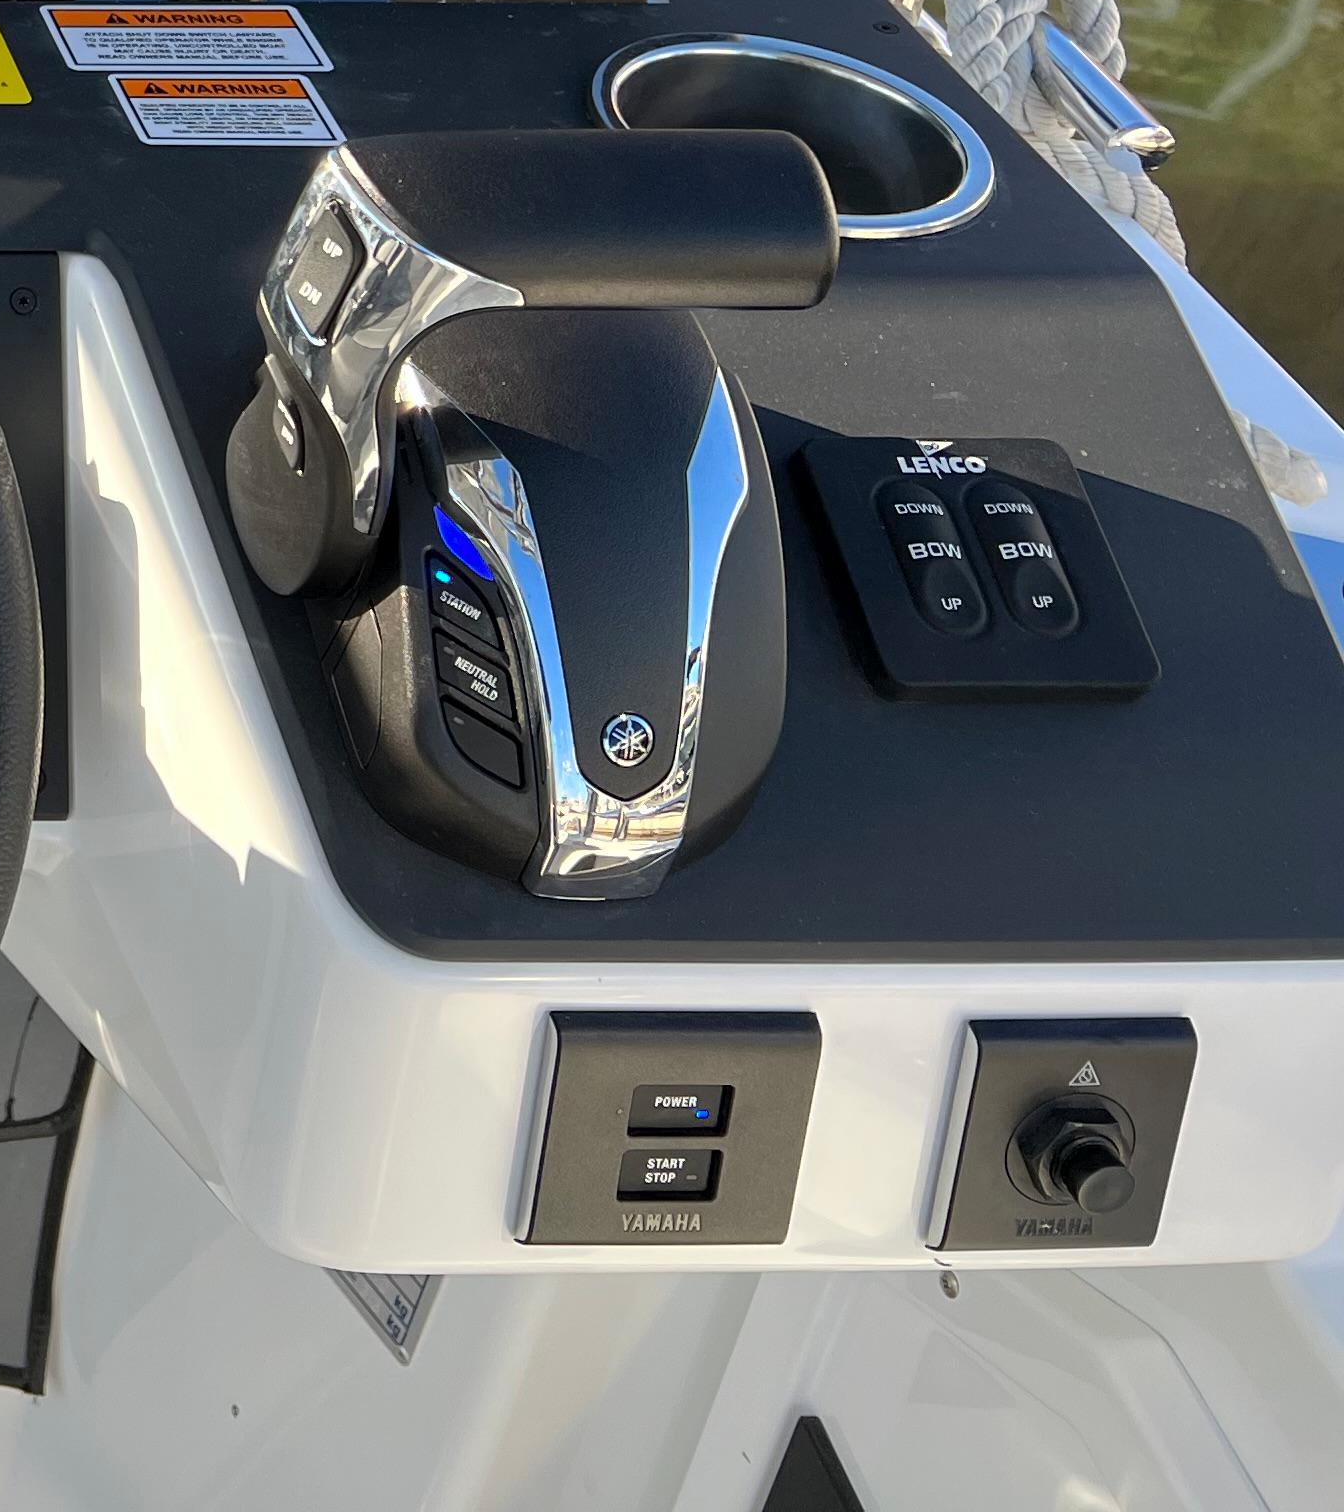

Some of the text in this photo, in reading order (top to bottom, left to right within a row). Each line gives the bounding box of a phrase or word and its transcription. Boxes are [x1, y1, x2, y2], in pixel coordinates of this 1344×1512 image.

[132, 14, 245, 25] WARNING
[172, 84, 287, 96] WARNING
[322, 237, 343, 258] UP
[298, 280, 323, 306] DN
[896, 456, 987, 475] LENCO
[894, 502, 945, 516] DOWN
[983, 502, 1034, 516] DOWN
[908, 542, 962, 561] BOW
[998, 542, 1053, 561] BOW
[440, 590, 482, 622] STATION
[940, 597, 962, 611] UP
[1031, 595, 1054, 609] UP
[455, 656, 499, 689] NEUTRAL
[470, 678, 499, 702] HOLD
[654, 1096, 697, 1108] POWER
[646, 1158, 686, 1170] START
[644, 1172, 676, 1183] STOP
[621, 1213, 702, 1233] YAMAHA
[1015, 1216, 1094, 1237] YAMAHA
